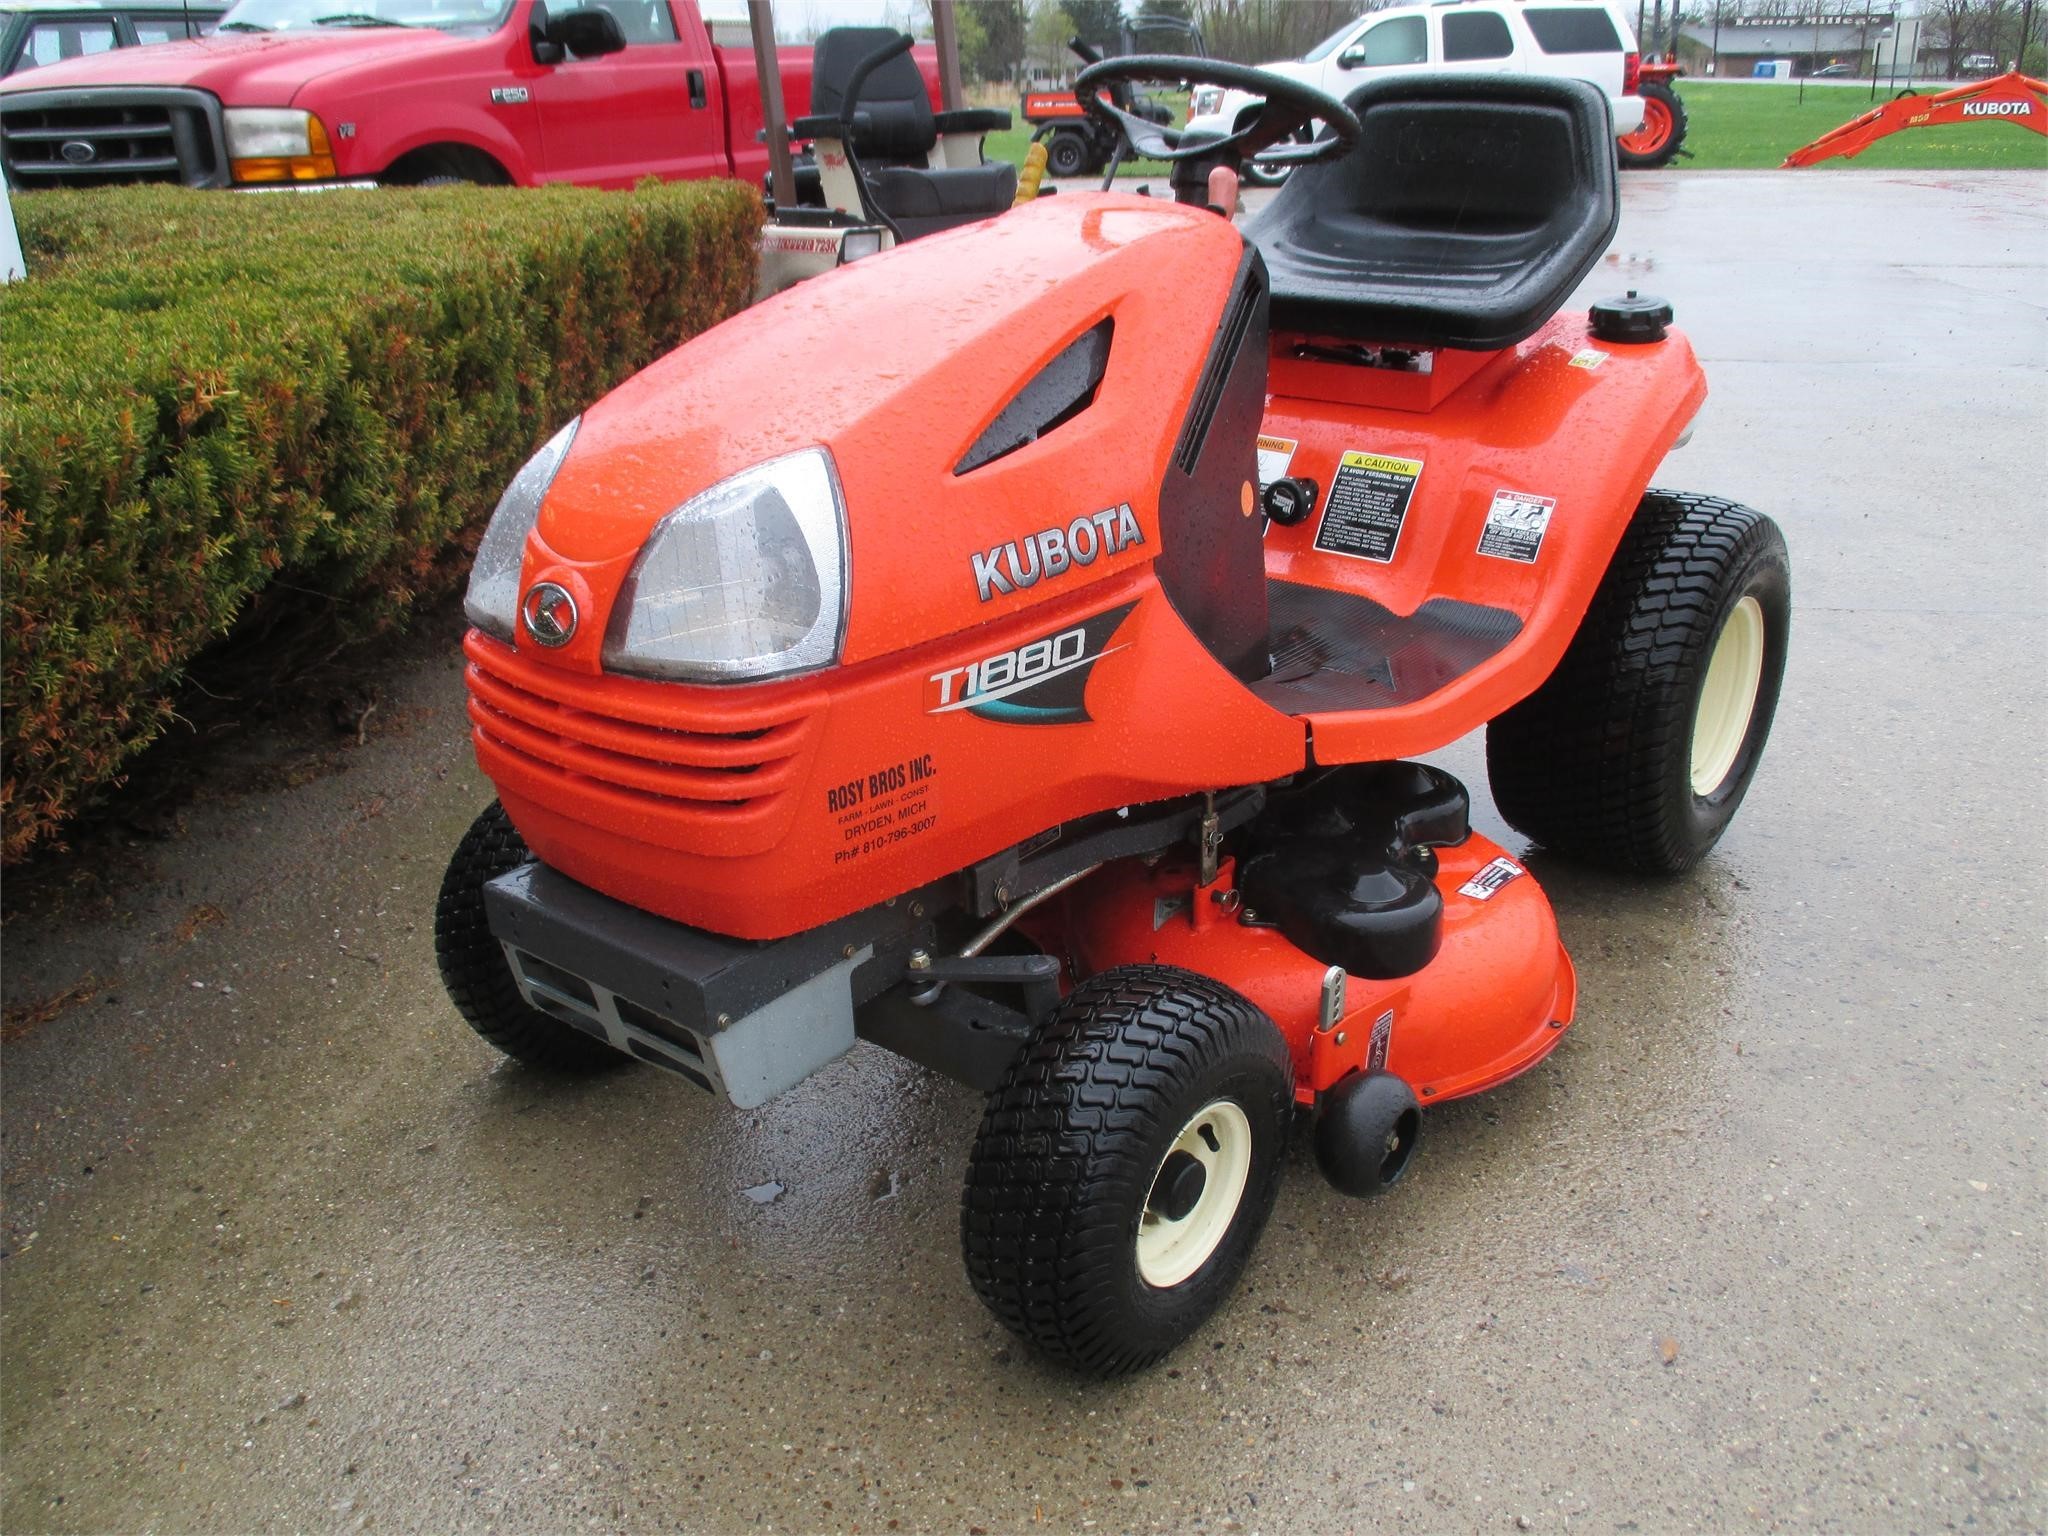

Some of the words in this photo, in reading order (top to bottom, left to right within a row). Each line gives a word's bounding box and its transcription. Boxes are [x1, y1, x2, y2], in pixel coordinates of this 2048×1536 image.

[1963, 102, 2031, 115] KUBOTA
[815, 238, 839, 254] 723K
[970, 502, 1146, 603] KUBOTA
[930, 628, 1086, 705] T1880
[828, 779, 865, 813] ROSY
[869, 764, 906, 799] BROS
[909, 754, 937, 783] INC.
[838, 810, 863, 825] FARM
[869, 798, 894, 814] LAWN
[900, 784, 929, 802] CONST
[834, 845, 860, 864] Ph#
[863, 815, 937, 854] 810-796-3007
[844, 814, 895, 840] DRYDEN,
[898, 800, 927, 820] MICH
